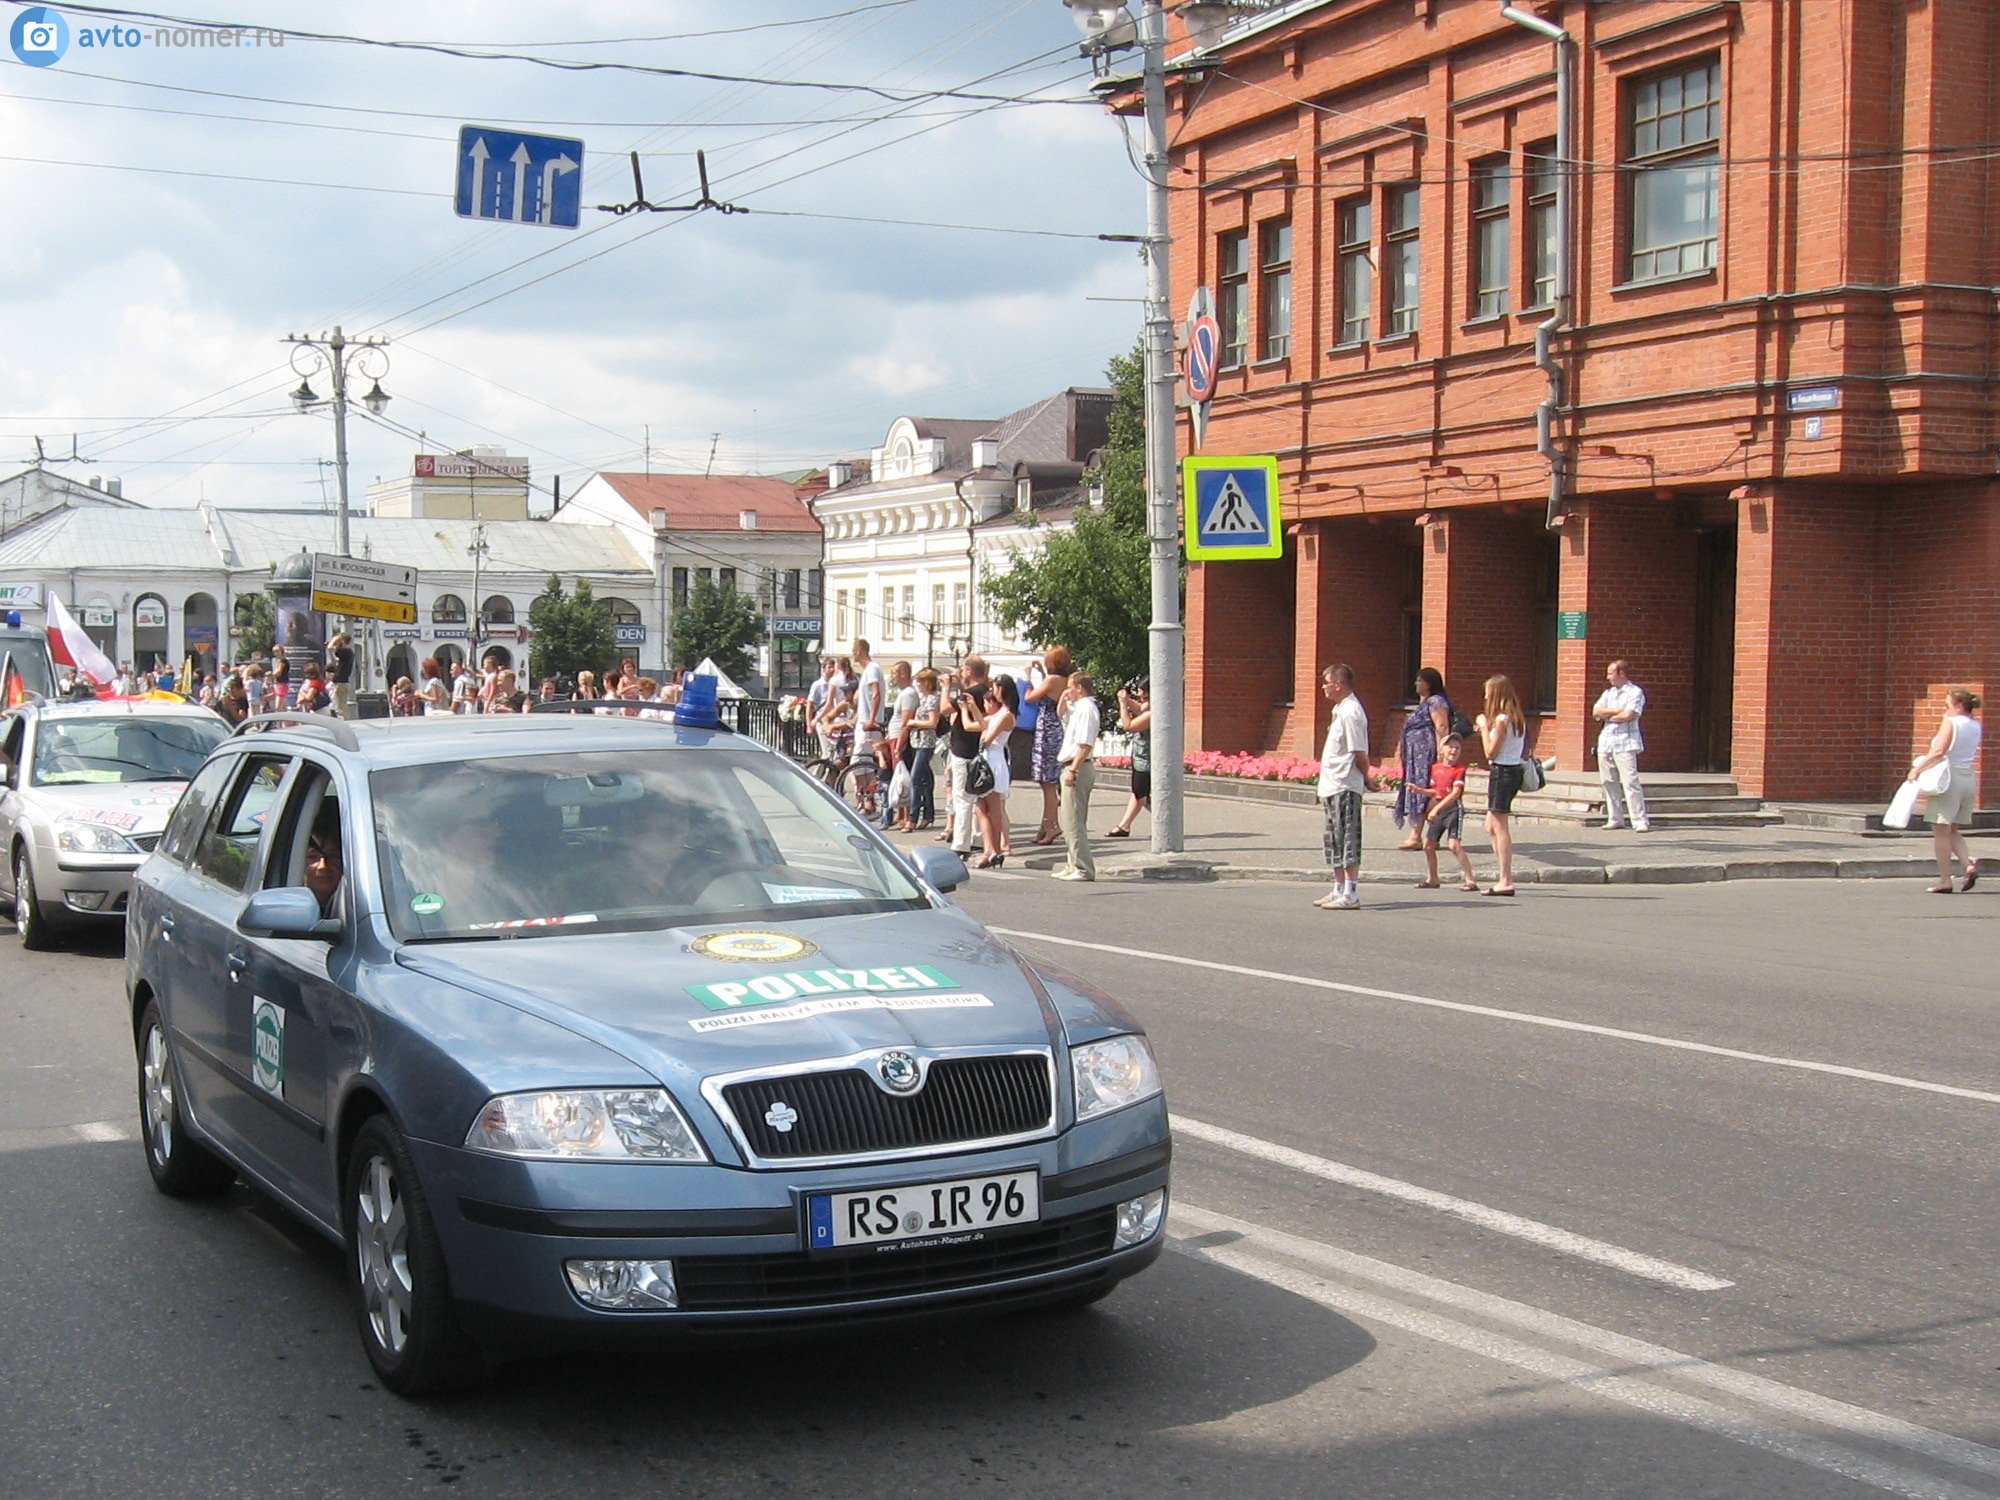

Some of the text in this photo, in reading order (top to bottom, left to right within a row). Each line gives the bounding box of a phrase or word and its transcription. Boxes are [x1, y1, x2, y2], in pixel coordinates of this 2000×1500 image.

[1807, 422, 1818, 434] 27
[340, 563, 386, 576] МОСКОВСКАЯ
[330, 580, 365, 591] ГАГАРИНА
[319, 598, 355, 610] ТОРГОВЫЕ
[706, 966, 940, 1007] POLIZEI
[697, 1016, 754, 1029] POLIZEI
[817, 1179, 1025, 1238] D RS IR 96
